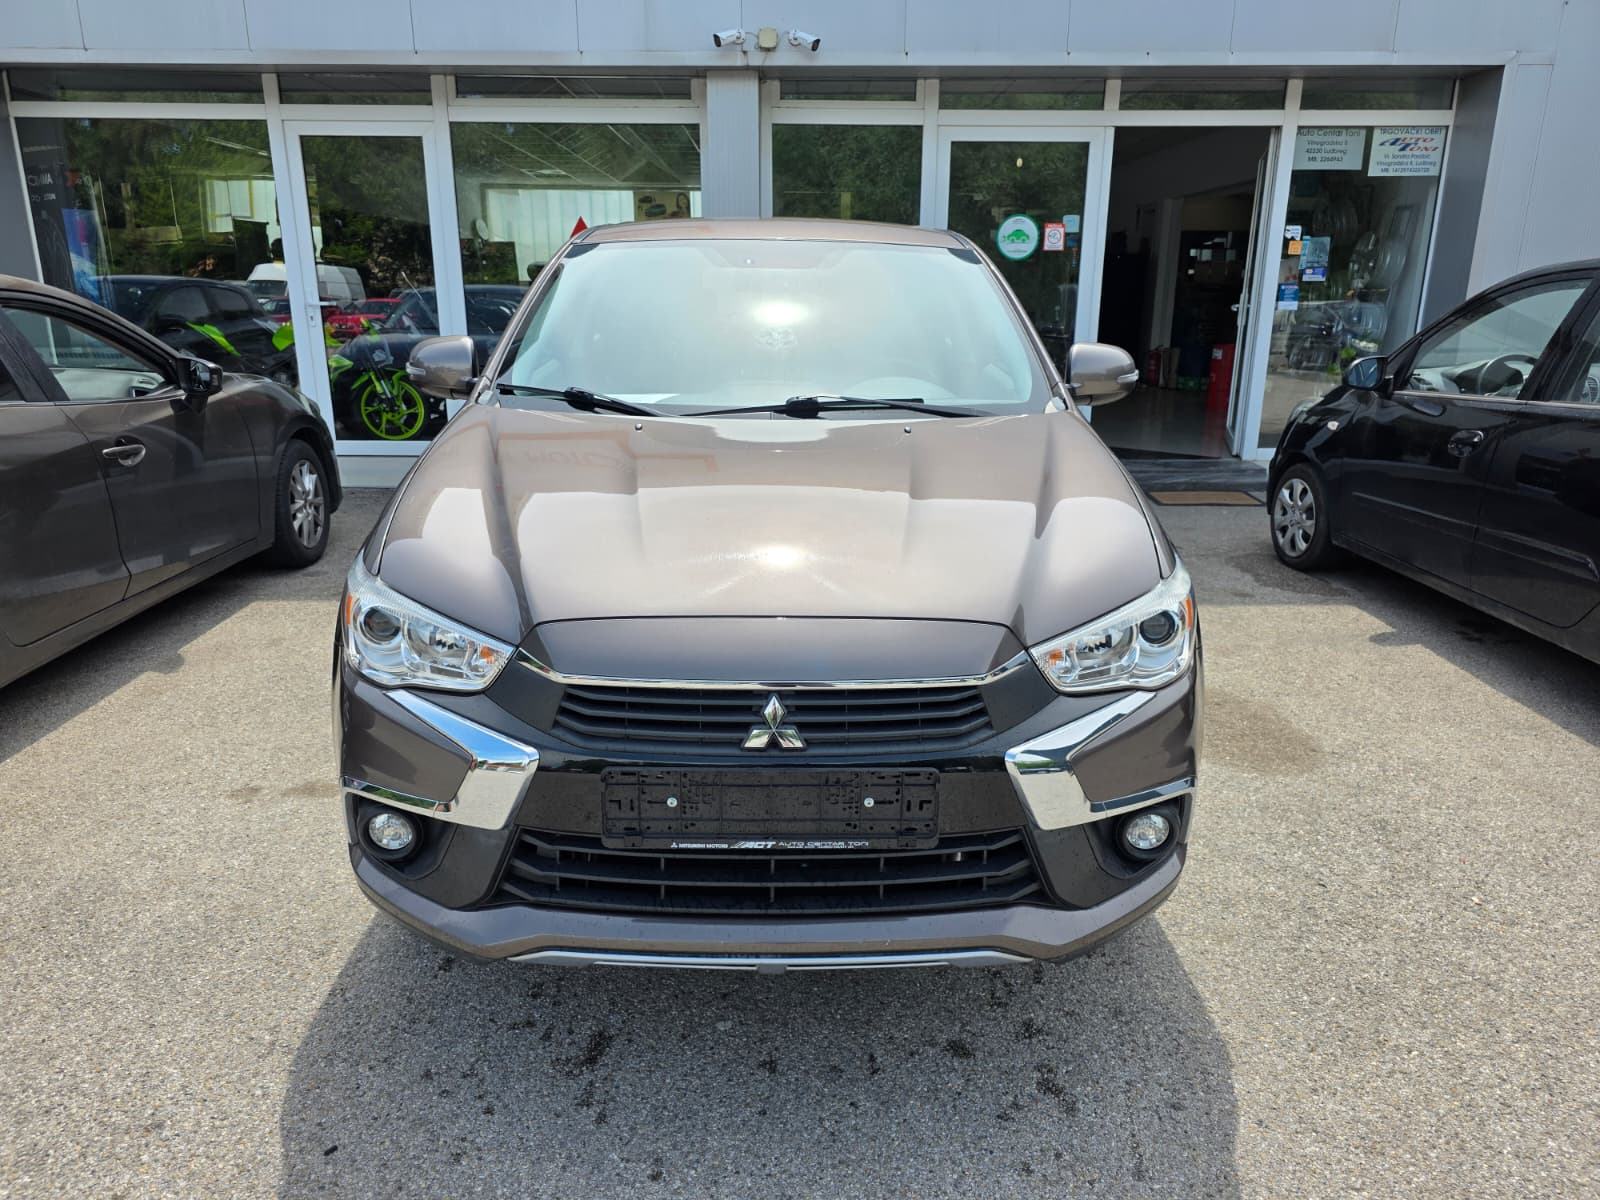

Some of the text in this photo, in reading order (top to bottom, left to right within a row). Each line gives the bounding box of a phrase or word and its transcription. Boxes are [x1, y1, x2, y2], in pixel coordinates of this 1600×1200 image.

[1297, 128, 1314, 137] Auto
[1345, 128, 1361, 137] Toni
[1378, 137, 1435, 146] AUTO
[1398, 143, 1440, 152] TONI
